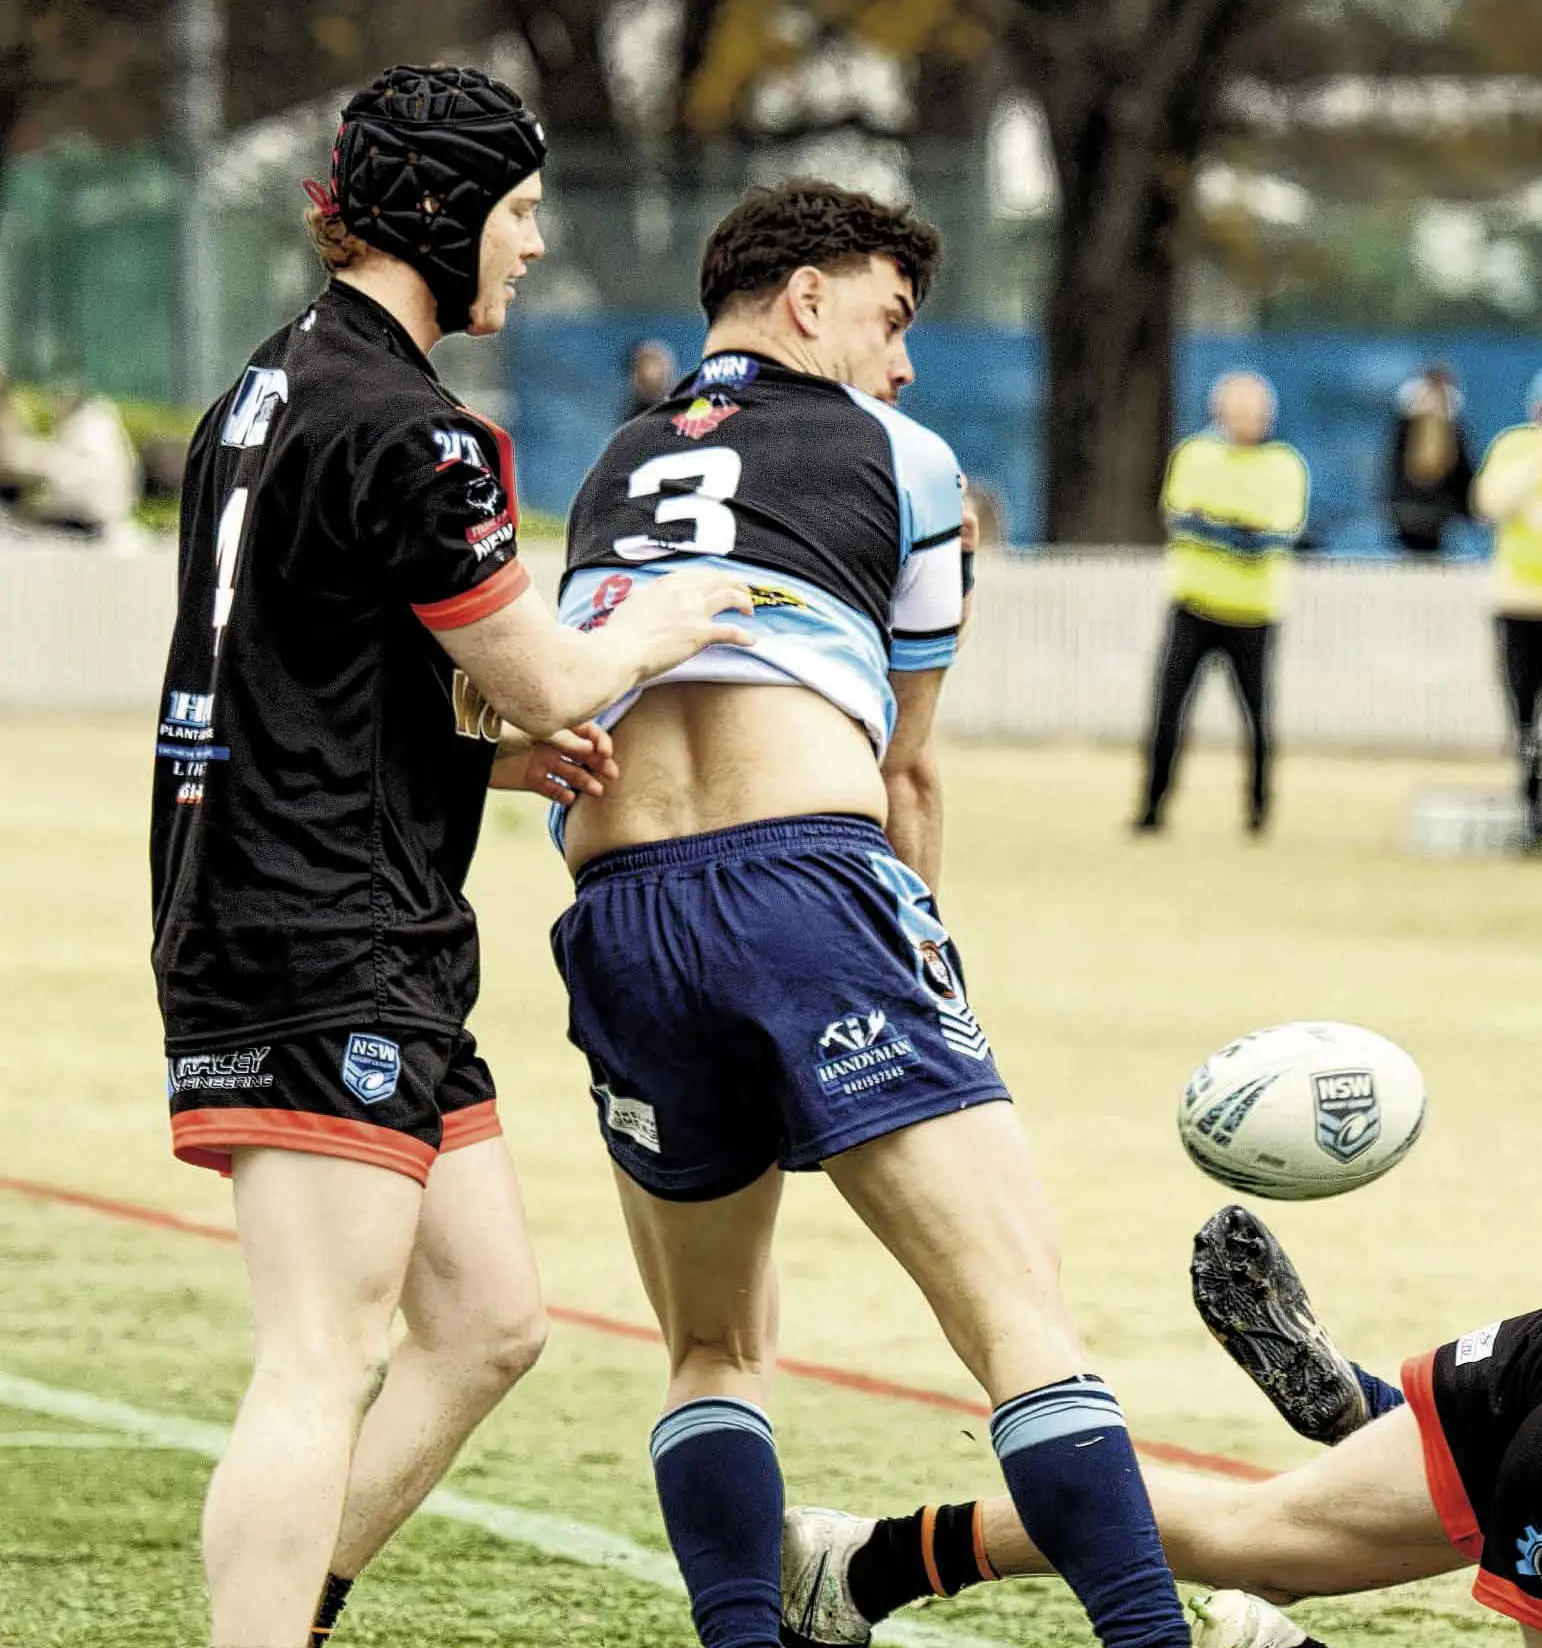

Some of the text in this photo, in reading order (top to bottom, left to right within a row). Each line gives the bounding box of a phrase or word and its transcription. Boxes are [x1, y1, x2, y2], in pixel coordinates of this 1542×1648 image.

[613, 445, 742, 561] 3
[352, 1038, 396, 1062] NSW
[819, 1039, 912, 1082] HANDYMAN
[1318, 1074, 1373, 1101] NSW
